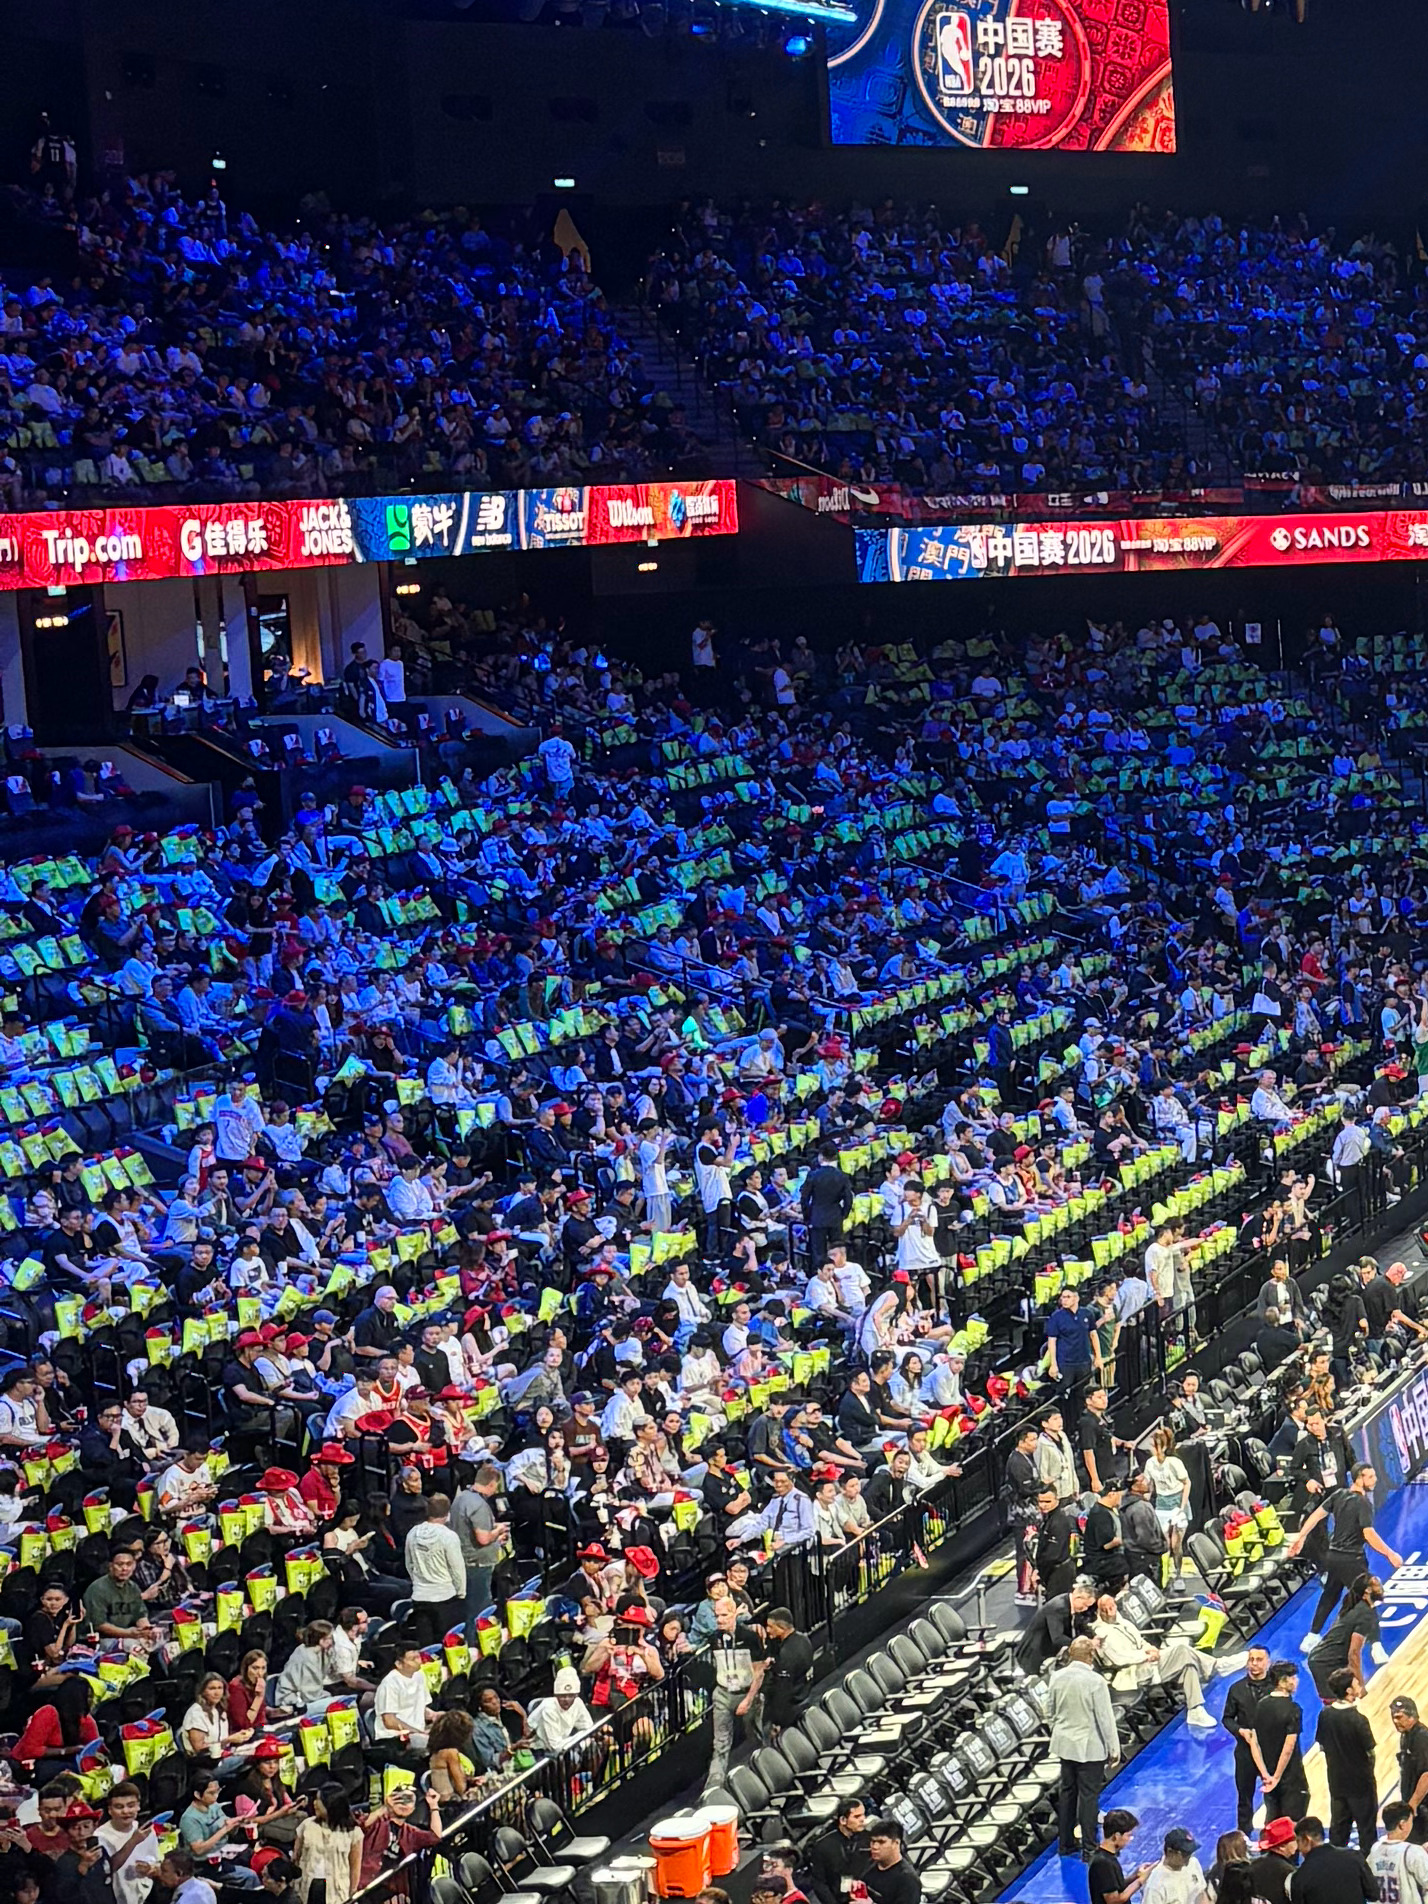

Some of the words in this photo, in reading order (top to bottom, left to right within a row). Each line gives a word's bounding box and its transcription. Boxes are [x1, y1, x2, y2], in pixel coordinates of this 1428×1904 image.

[977, 16, 1064, 58] 中国赛
[979, 58, 1037, 97] 2026
[300, 504, 351, 532] JACK&
[544, 512, 585, 532] TISSOT
[606, 499, 654, 530] Wilson
[42, 528, 142, 572] Trip.com
[204, 518, 268, 557] 佳得乐
[301, 529, 353, 556] JONES
[1293, 525, 1370, 549] SANDS
